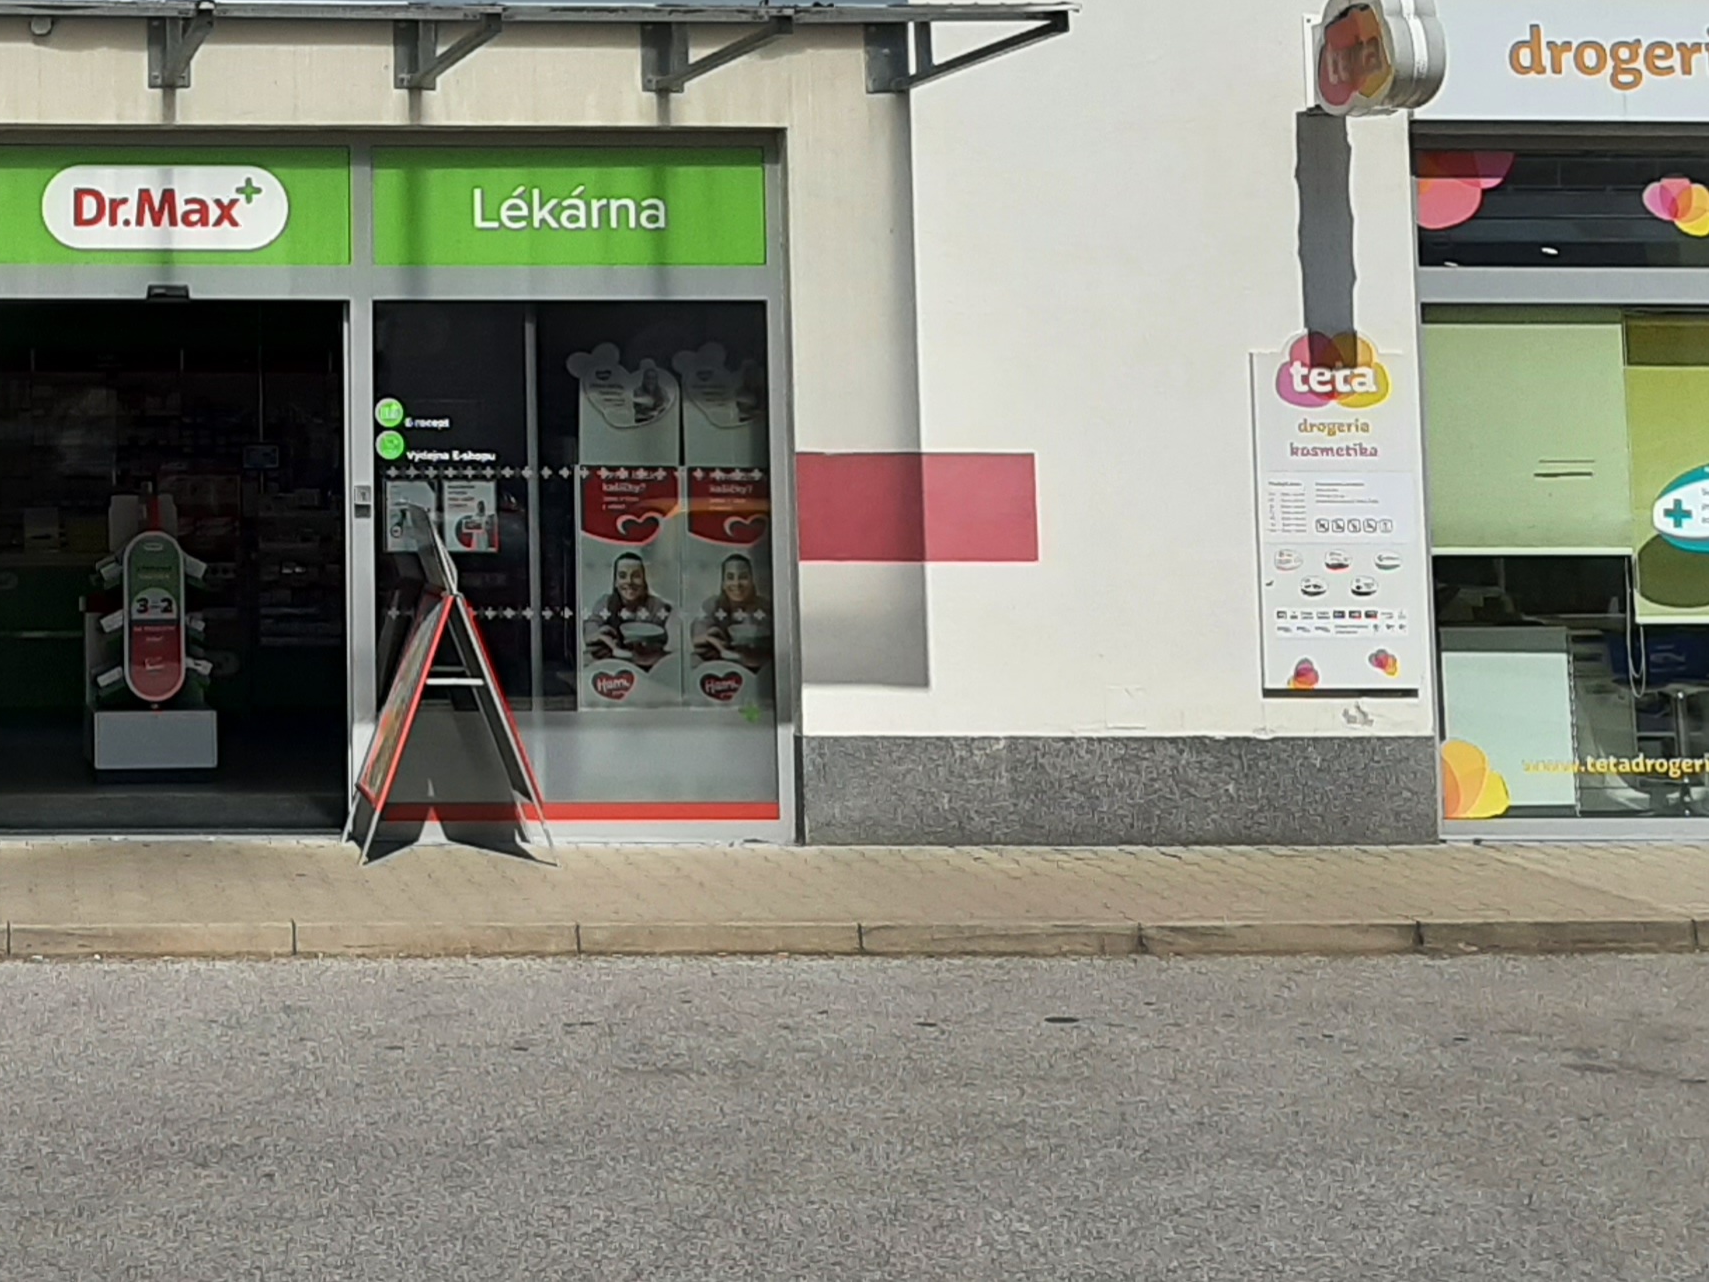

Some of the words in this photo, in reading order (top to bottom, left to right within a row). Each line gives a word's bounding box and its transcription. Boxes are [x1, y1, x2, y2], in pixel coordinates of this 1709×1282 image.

[471, 185, 667, 230] Lékárna
[1289, 359, 1378, 394] teta
[1289, 441, 1379, 458] kosmetika
